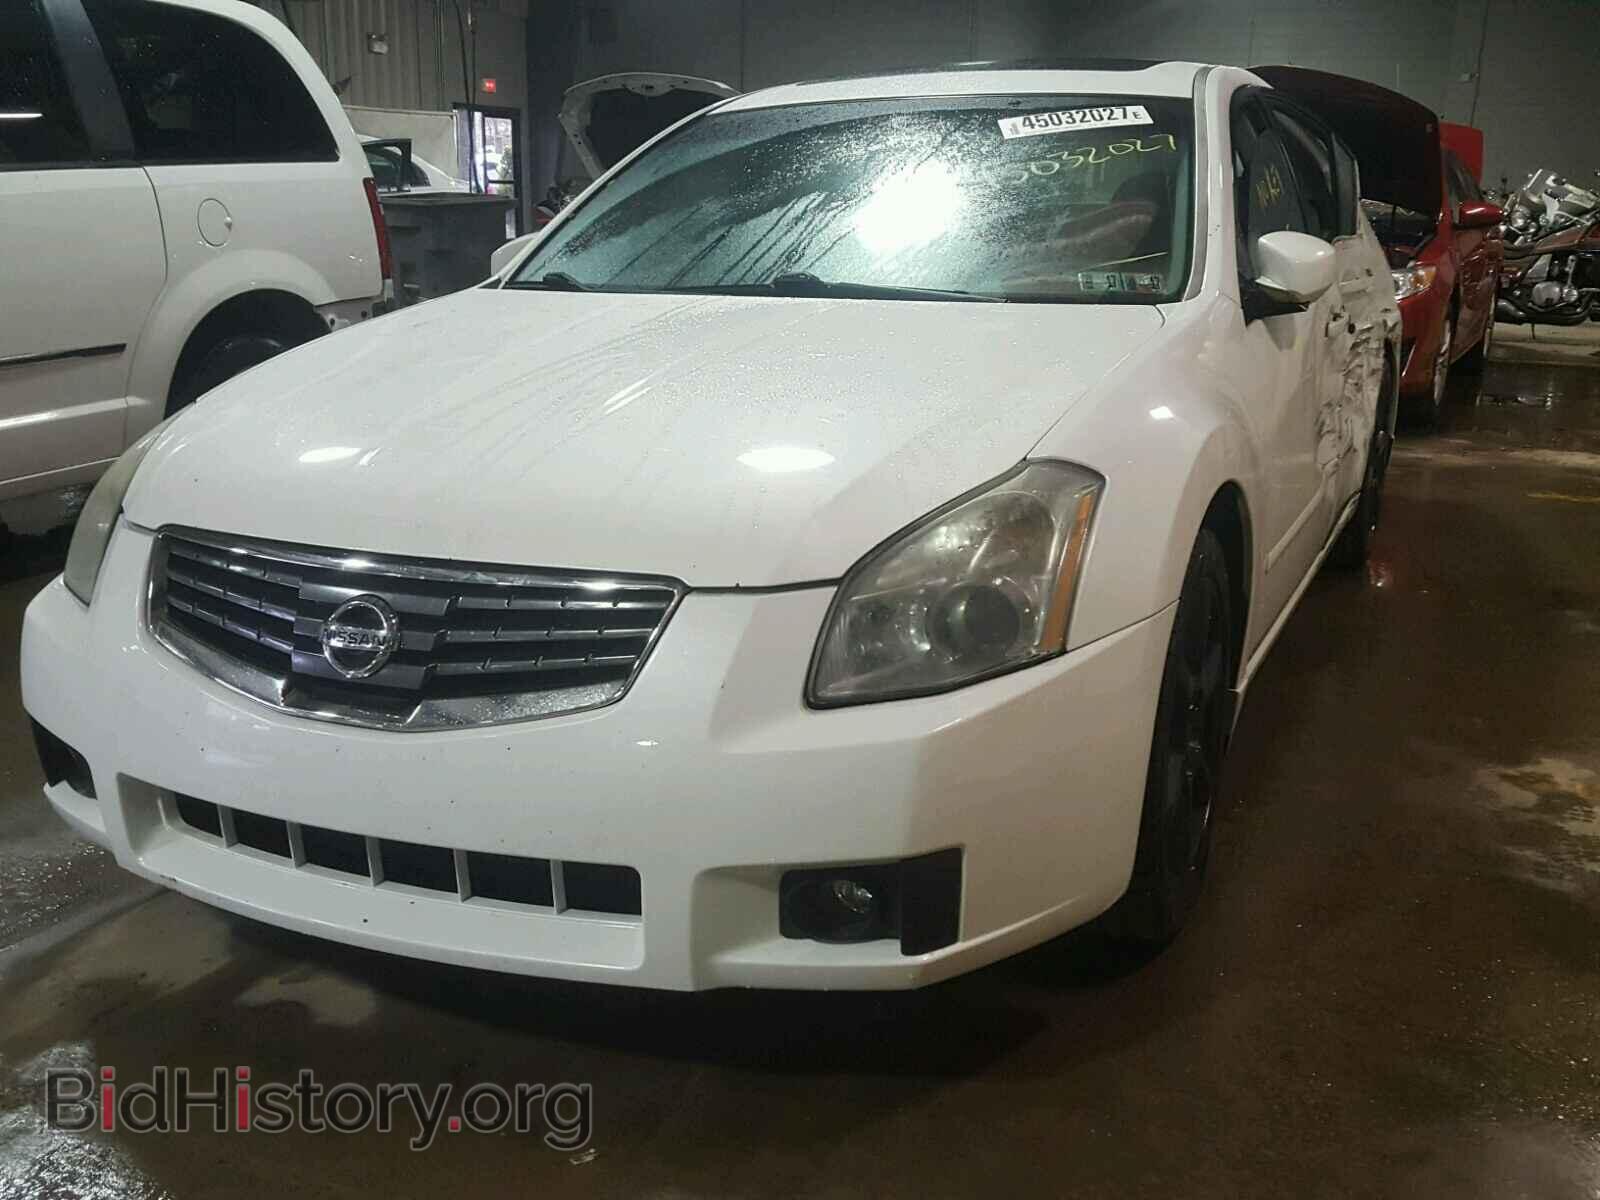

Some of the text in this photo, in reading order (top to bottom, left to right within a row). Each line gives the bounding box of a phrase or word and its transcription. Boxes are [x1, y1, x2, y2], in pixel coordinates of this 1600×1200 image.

[1022, 107, 1128, 130] 45032027
[1132, 111, 1143, 120] E
[322, 629, 386, 648] NISSAN
